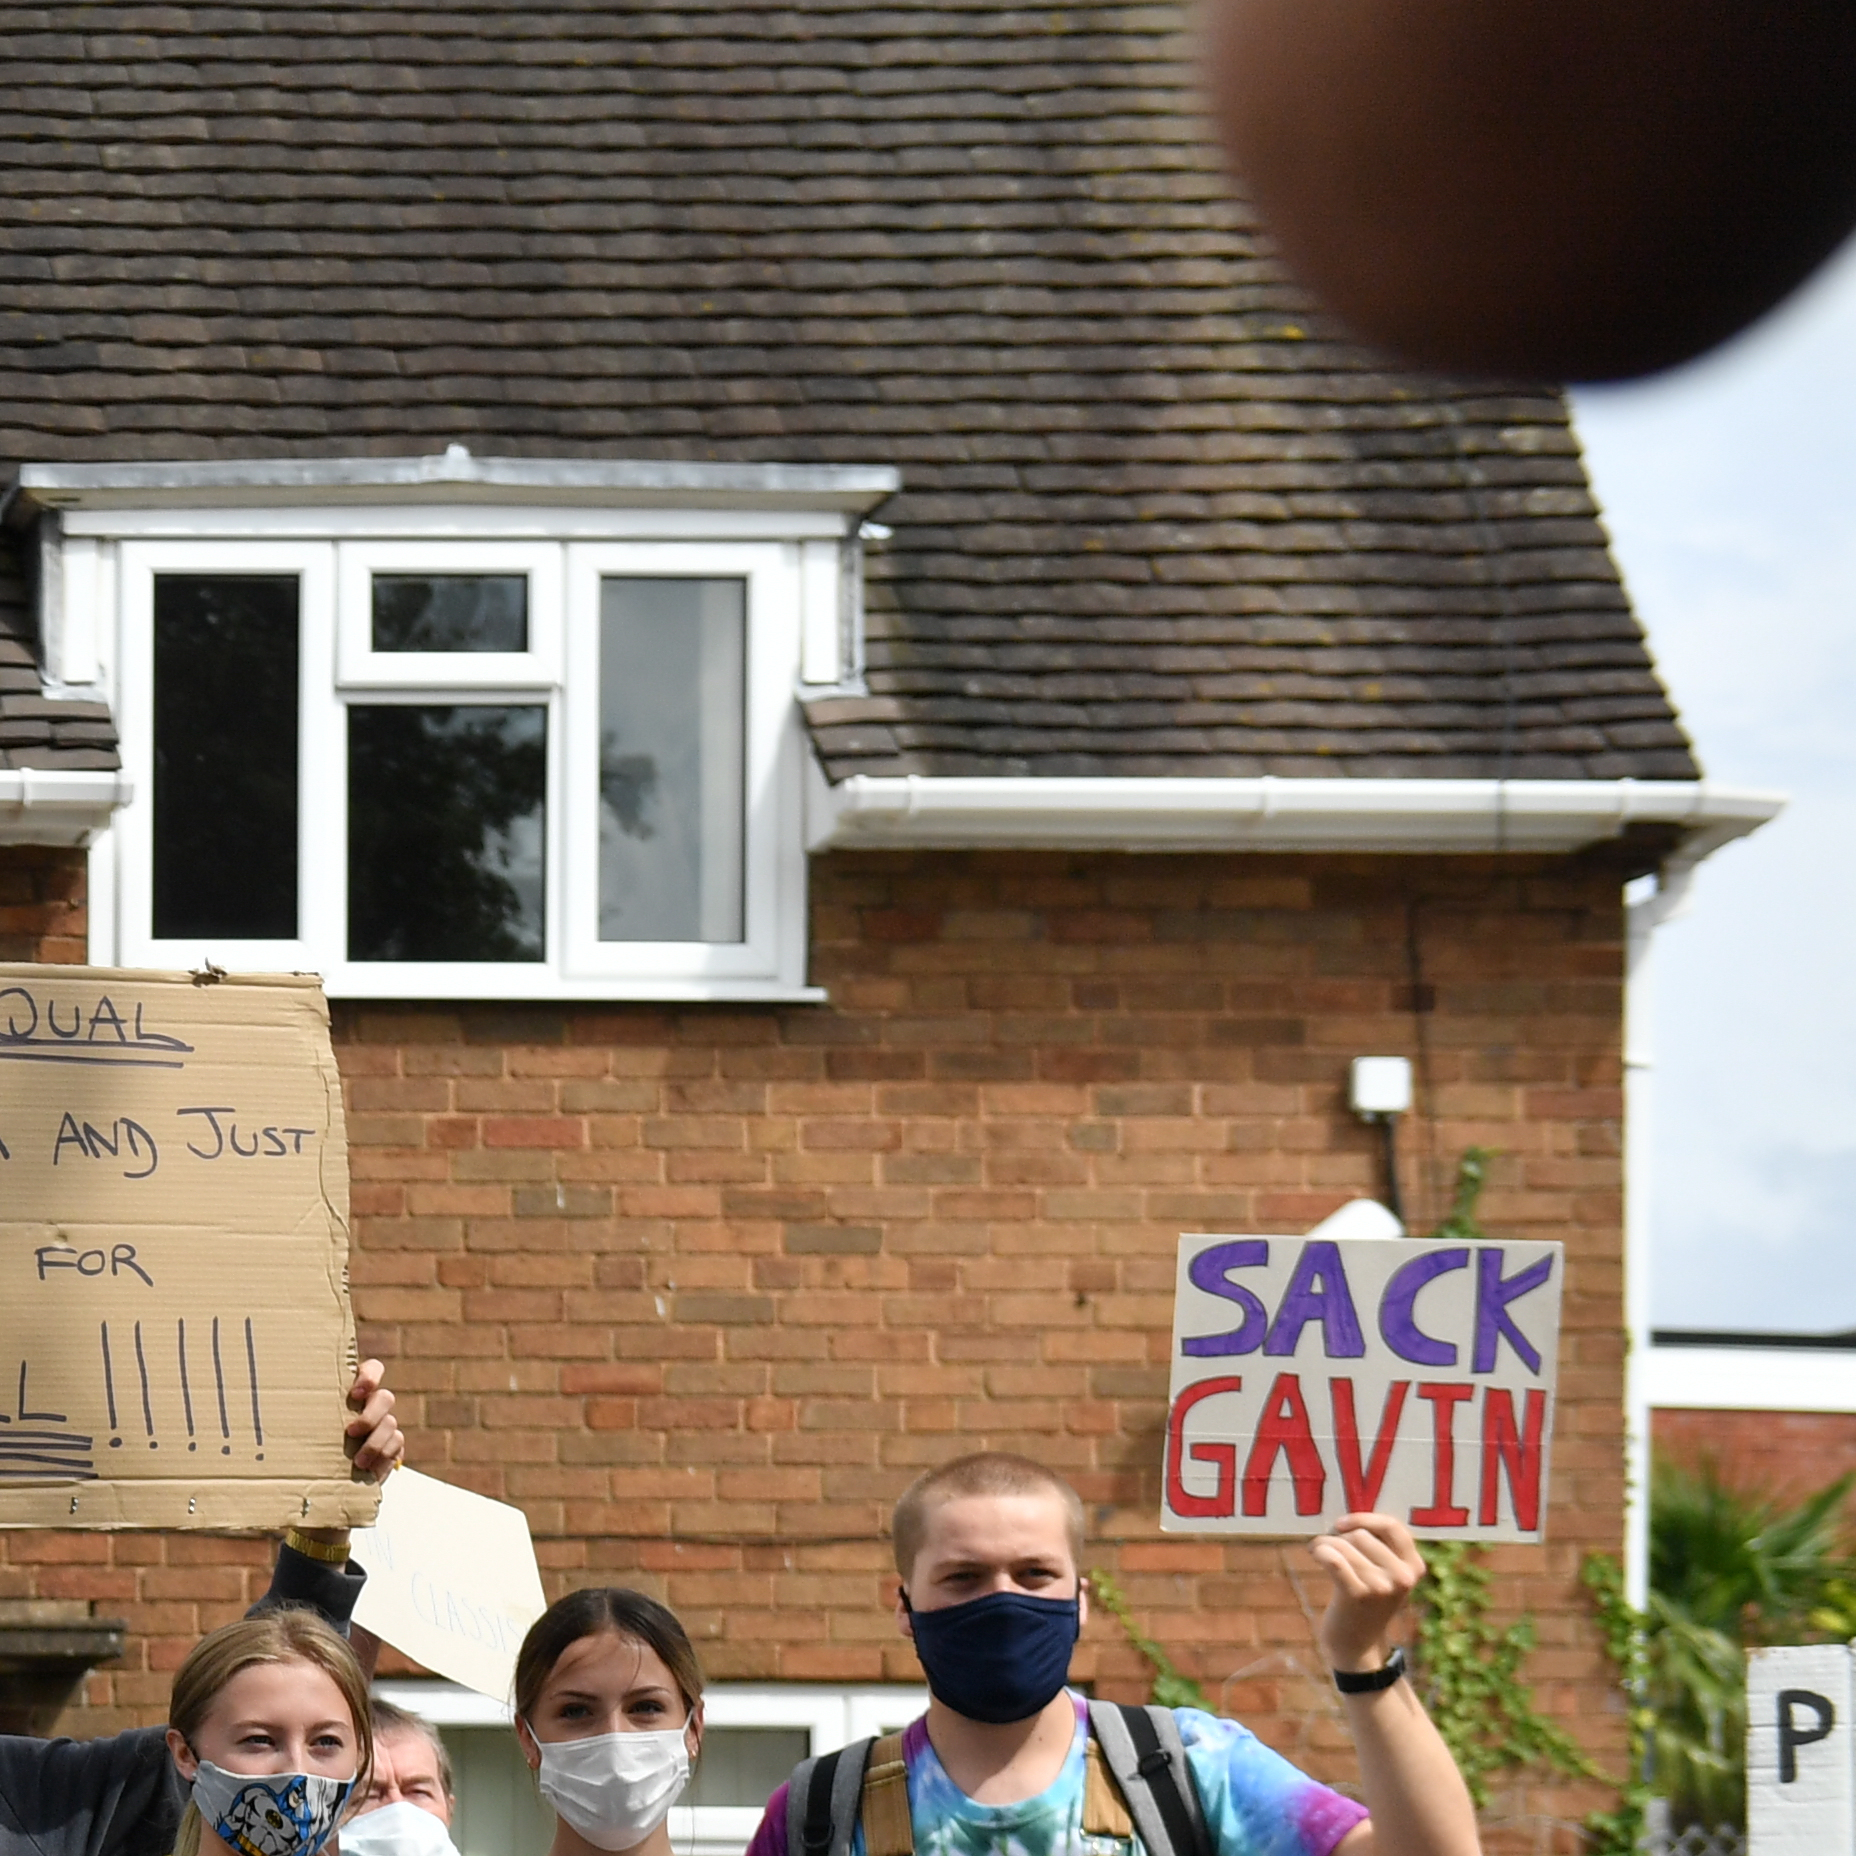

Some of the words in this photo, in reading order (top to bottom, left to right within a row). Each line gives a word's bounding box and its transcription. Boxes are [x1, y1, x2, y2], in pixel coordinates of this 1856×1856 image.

[54, 1111, 158, 1179] AND
[177, 1107, 317, 1160] JUST
[34, 1243, 154, 1288] FOR
[1181, 1239, 1555, 1376] SACK
[1166, 1371, 1547, 1531] GAVIN
